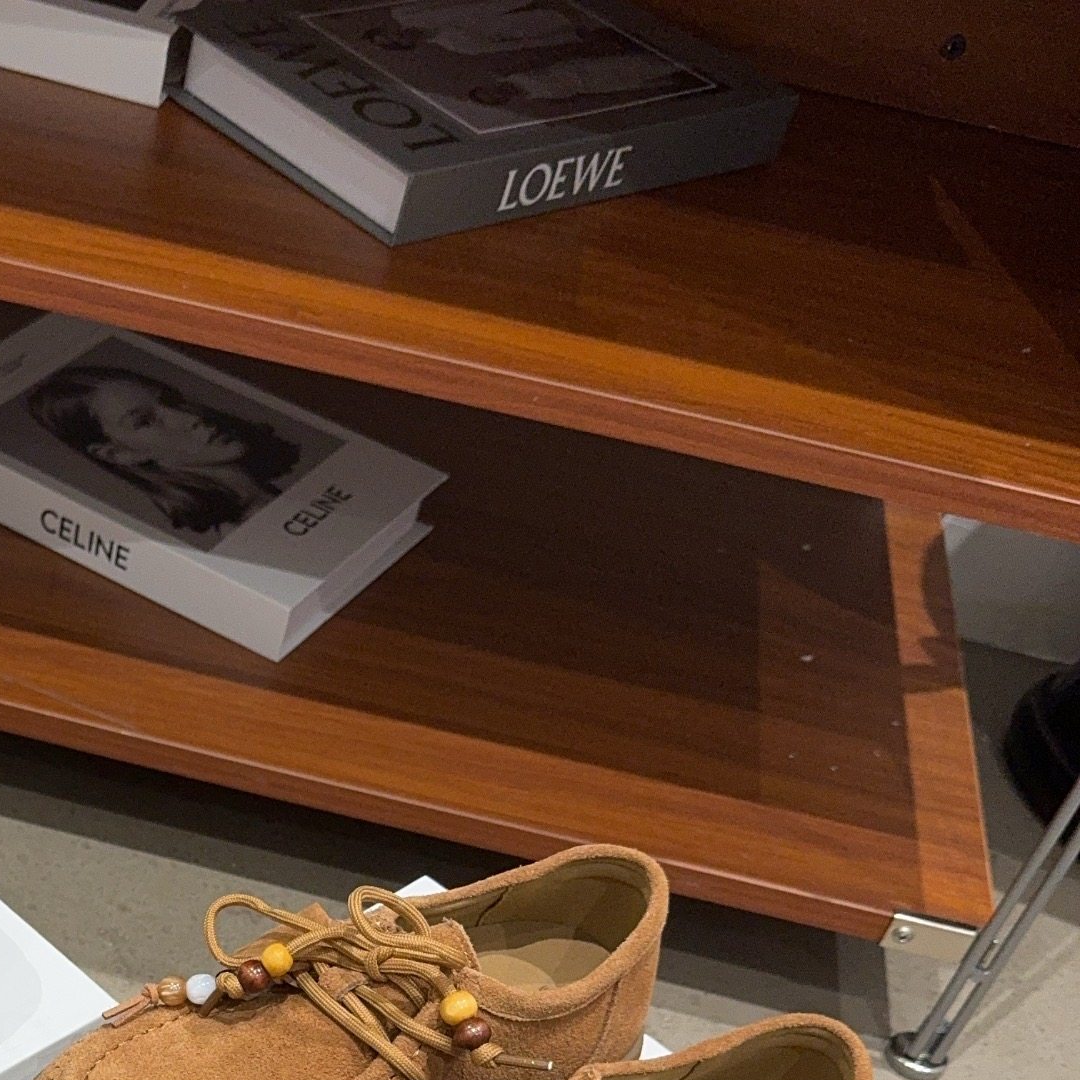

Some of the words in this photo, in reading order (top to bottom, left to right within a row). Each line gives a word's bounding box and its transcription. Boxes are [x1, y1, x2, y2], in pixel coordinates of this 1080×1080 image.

[497, 146, 635, 212] LOEWE
[40, 509, 129, 571] CELINE
[284, 484, 353, 538] CELINE
